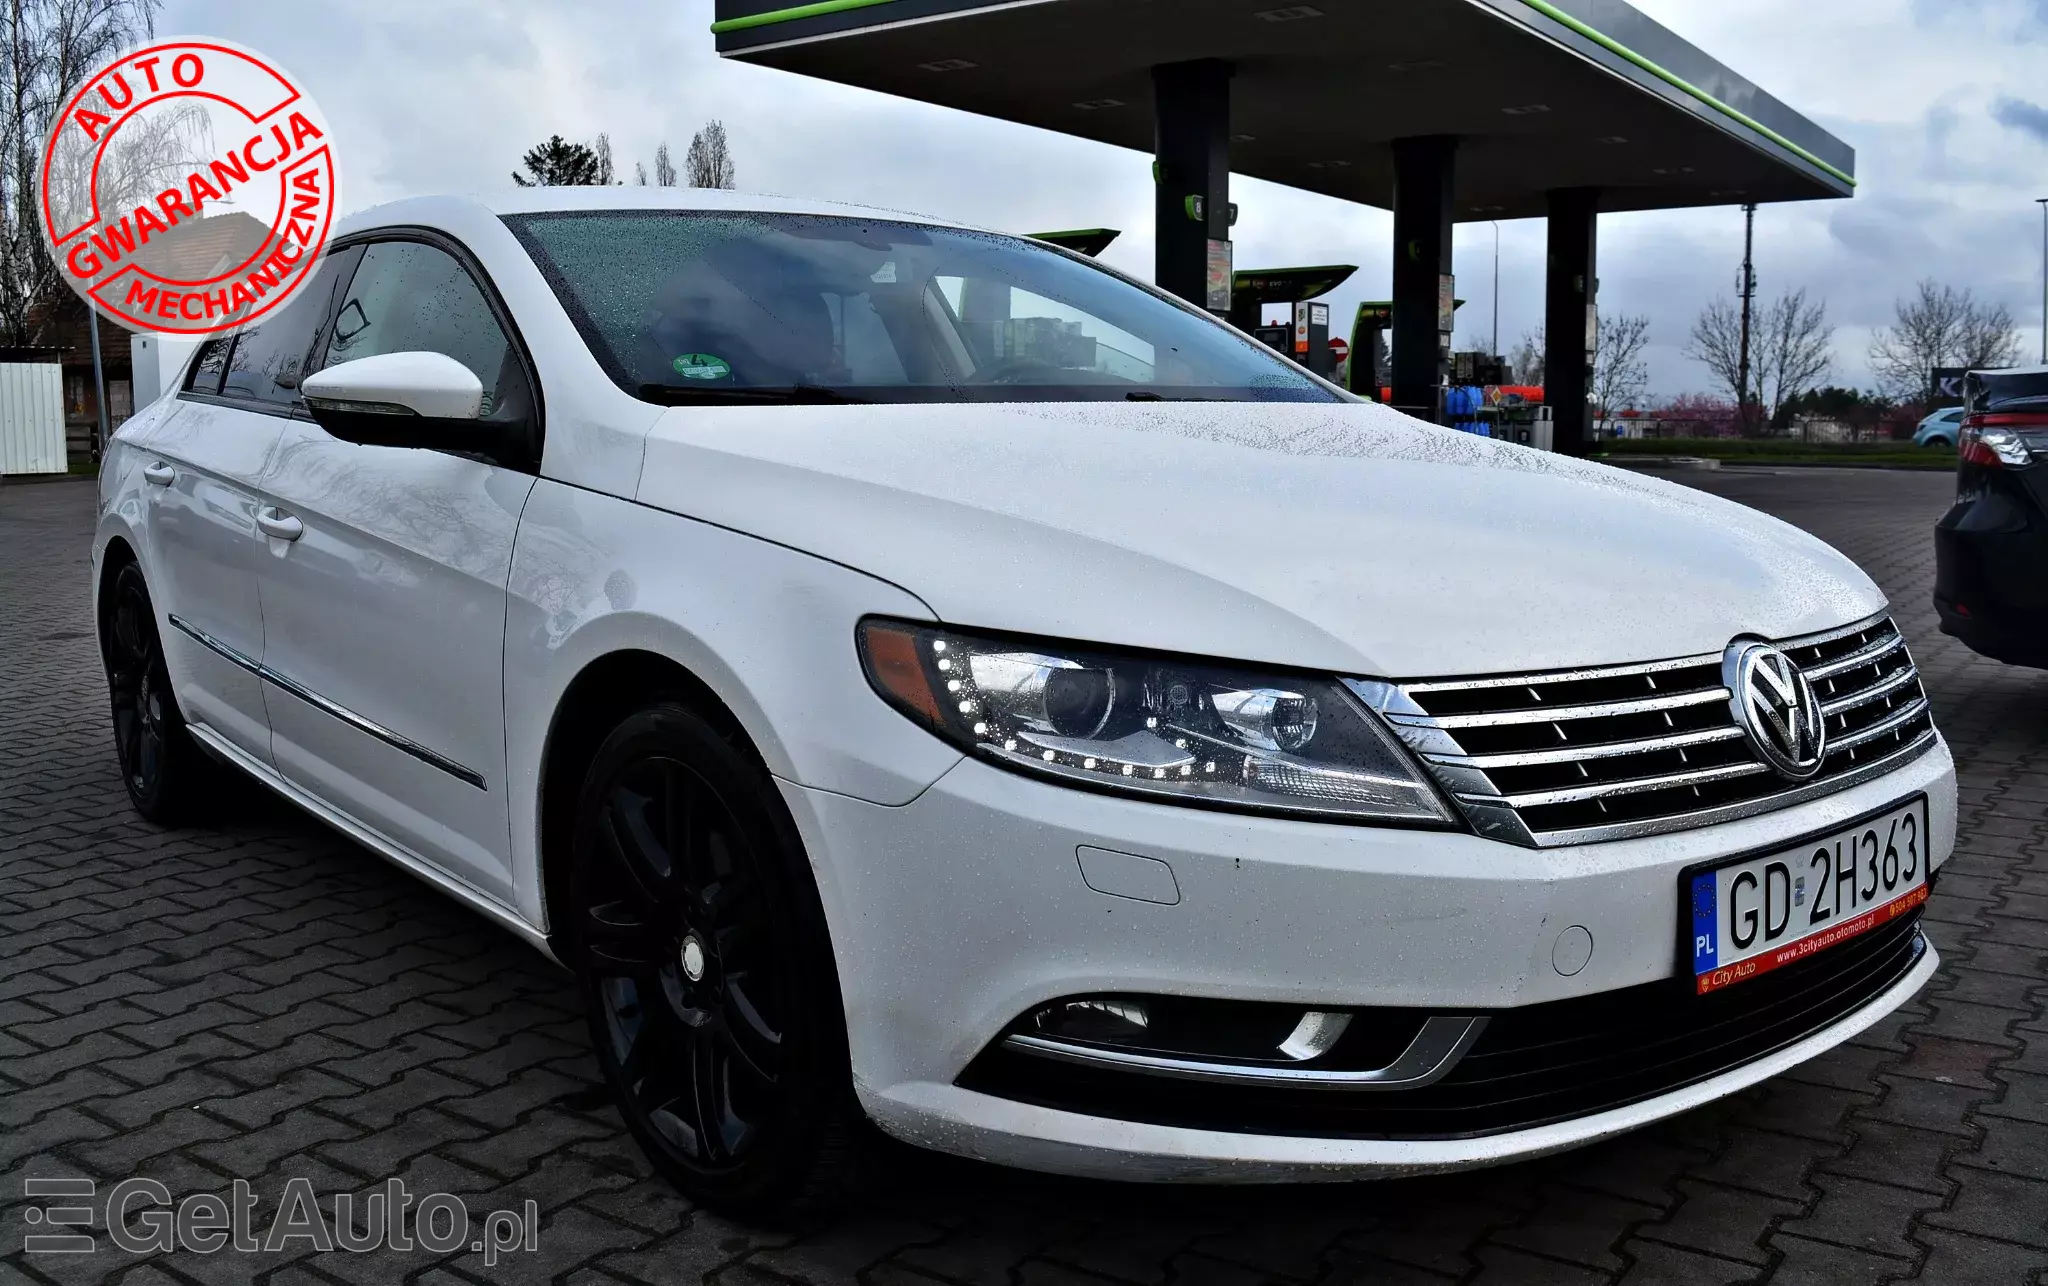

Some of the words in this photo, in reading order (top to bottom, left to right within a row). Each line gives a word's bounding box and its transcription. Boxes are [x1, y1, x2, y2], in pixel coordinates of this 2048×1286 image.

[1730, 861, 1791, 950] GD
[1809, 812, 1917, 926] 2H363
[1696, 934, 1714, 957] PL
[1776, 913, 1875, 963] www.3cityauto.otomoto.pl
[1712, 970, 1733, 986] City
[1735, 963, 1756, 978] Auto
